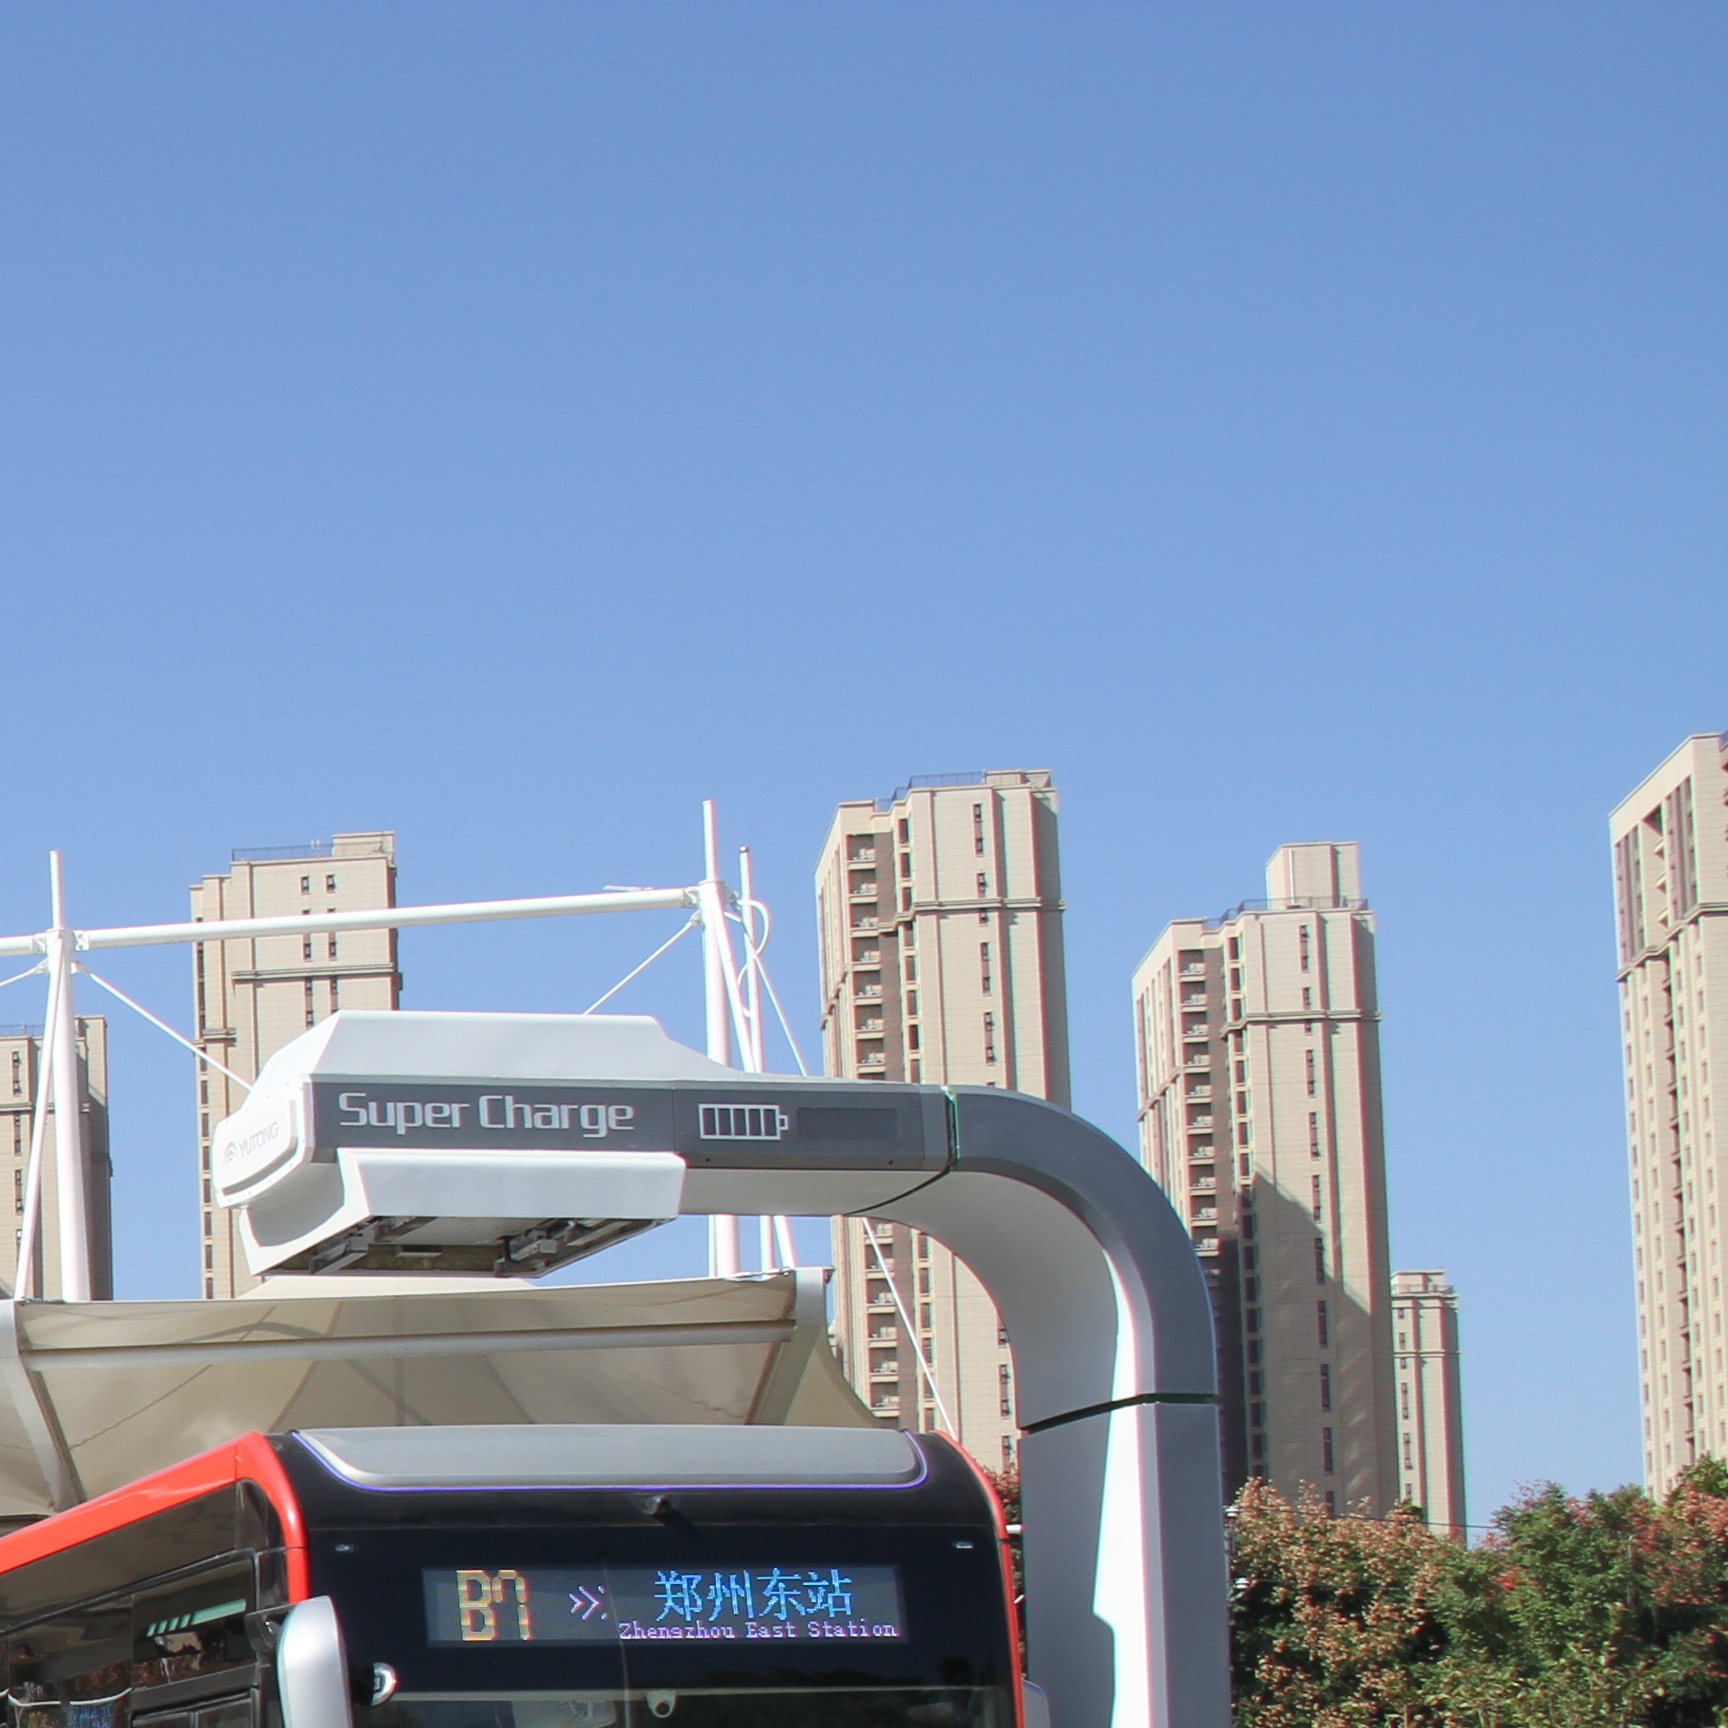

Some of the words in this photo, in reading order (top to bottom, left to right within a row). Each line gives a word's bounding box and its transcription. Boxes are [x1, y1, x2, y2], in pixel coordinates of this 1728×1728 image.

[338, 1093, 461, 1135] Super
[478, 1095, 634, 1138] Charge
[238, 1121, 280, 1158] YUTONG
[456, 1569, 532, 1641] B7
[654, 1567, 853, 1623] 郑州东站
[745, 1622, 796, 1639] East
[808, 1619, 898, 1639] Station
